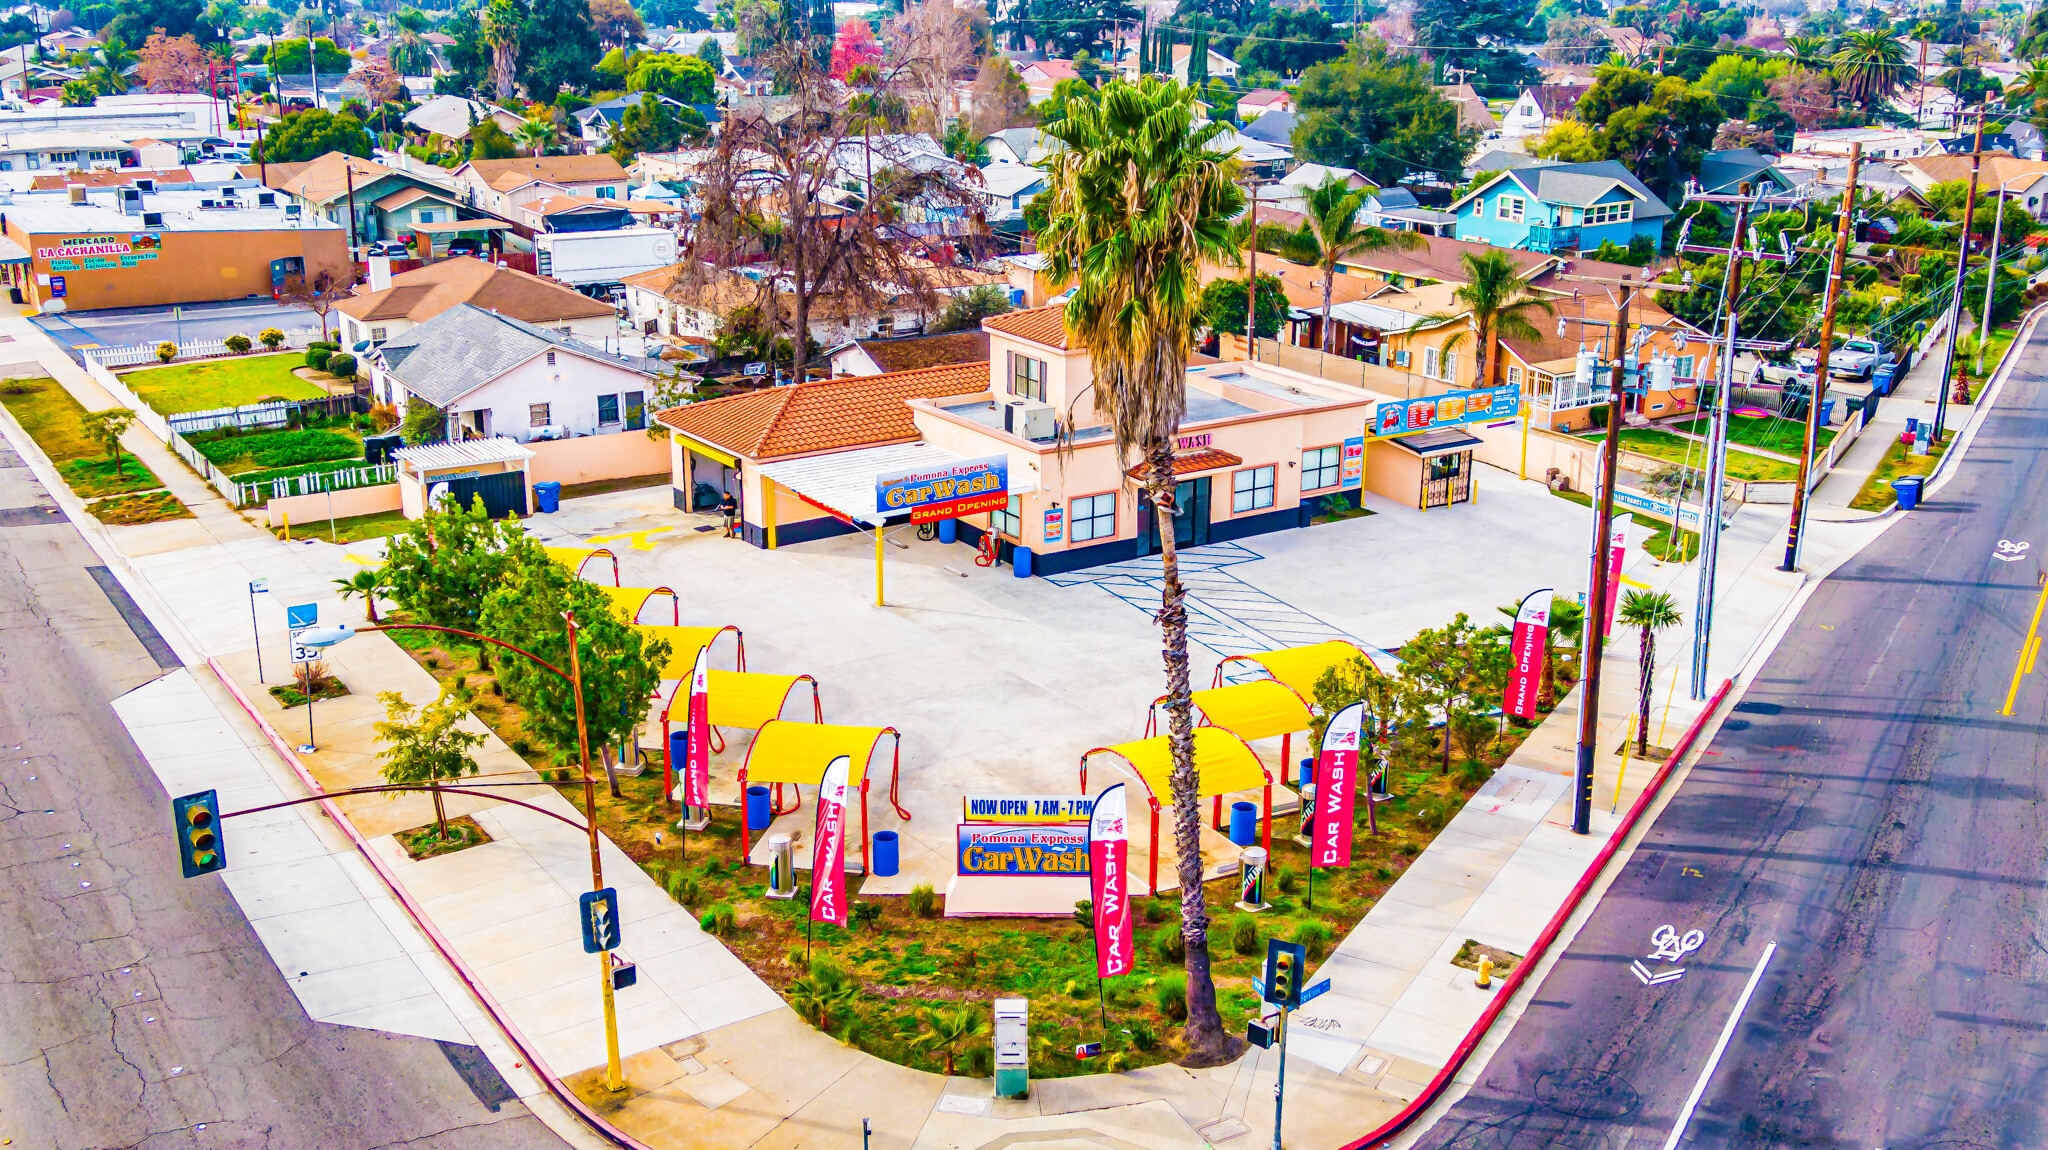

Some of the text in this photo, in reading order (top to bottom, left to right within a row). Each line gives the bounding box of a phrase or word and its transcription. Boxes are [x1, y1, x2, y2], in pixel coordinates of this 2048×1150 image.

[40, 244, 130, 258] LA CACHANILLA
[62, 236, 115, 246] MERCADO
[910, 470, 948, 483] Pomona
[952, 463, 988, 476] Express
[913, 497, 1006, 519] GRAND OPENING
[1515, 625, 1535, 715] GRAND OPENING
[971, 799, 997, 815] NOW
[1000, 799, 1027, 815] OPEN
[1323, 751, 1346, 864] CAR WASH
[972, 833, 1085, 846] Pomona Express
[822, 803, 839, 920] CAR WASH
[1105, 842, 1123, 975] CAR WASH
